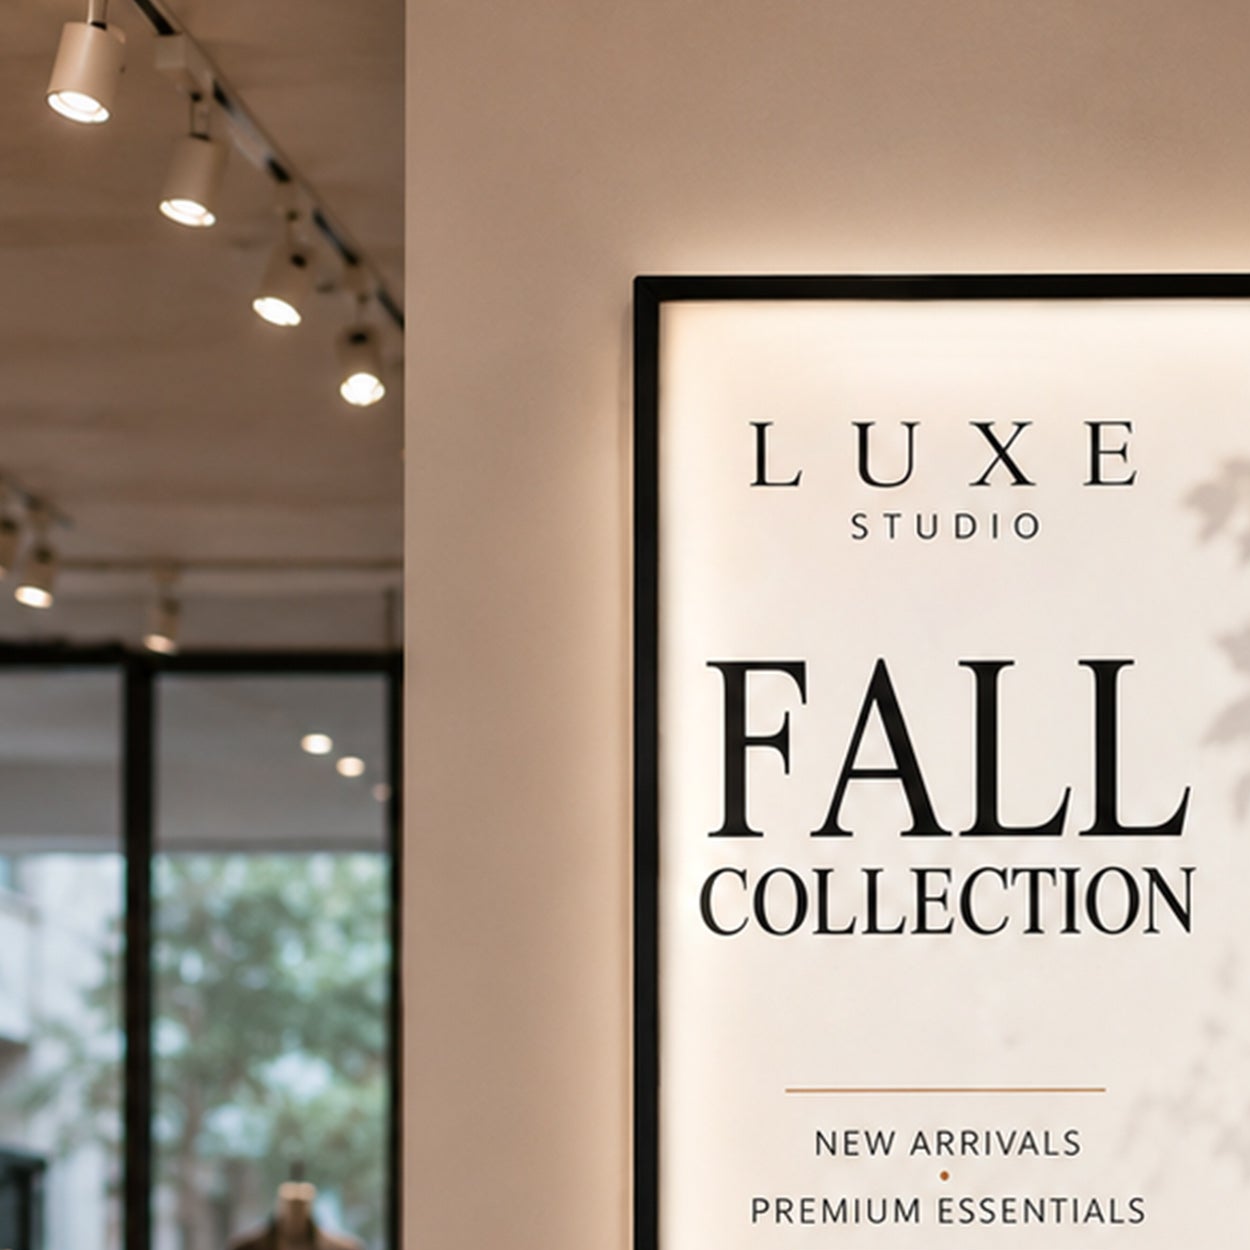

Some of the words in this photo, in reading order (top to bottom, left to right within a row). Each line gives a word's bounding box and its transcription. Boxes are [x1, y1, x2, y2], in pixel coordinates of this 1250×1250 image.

[750, 421, 1137, 488] LUXE
[851, 512, 1041, 541] STUDIO
[705, 657, 1191, 838] FALL
[699, 865, 1197, 937] COLLECTION
[815, 1130, 896, 1156] NEW
[909, 1129, 1081, 1157] ARRIVALS
[751, 1197, 920, 1225] PREMIUM
[938, 1197, 1146, 1225] ESSENTIALS
